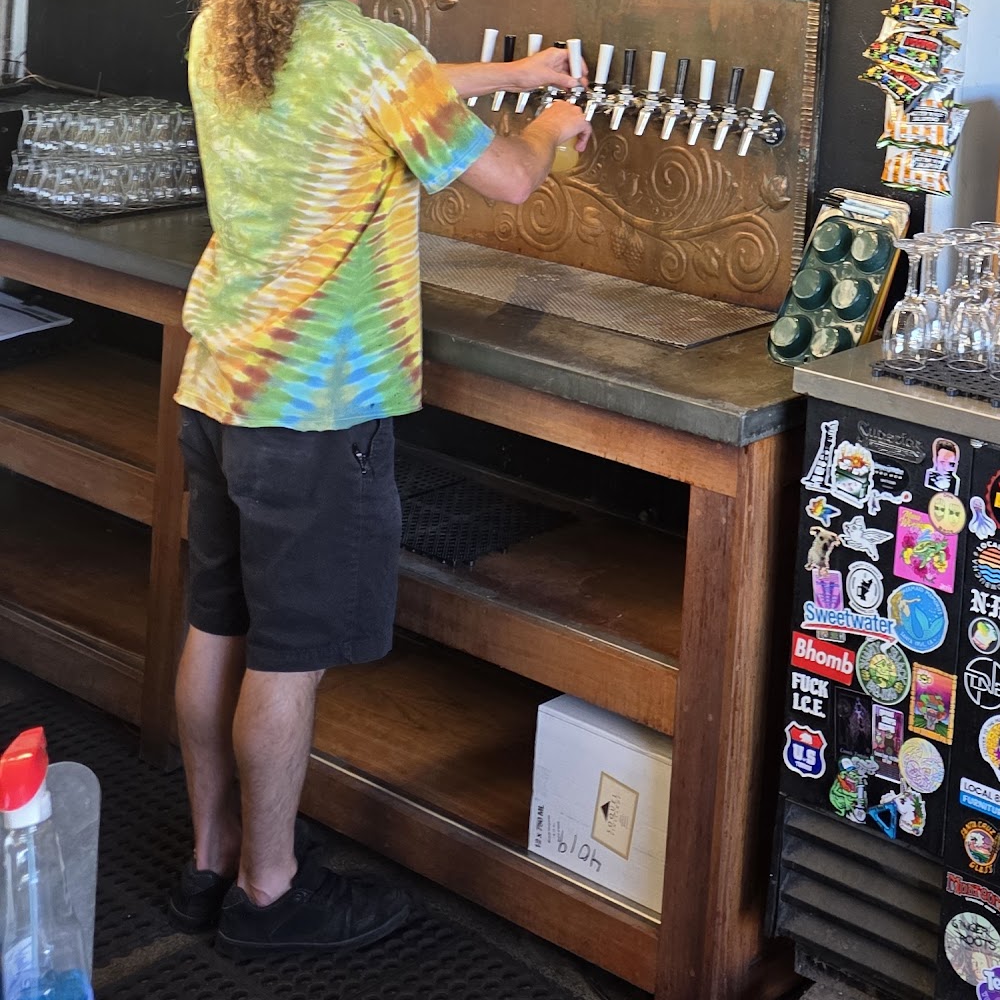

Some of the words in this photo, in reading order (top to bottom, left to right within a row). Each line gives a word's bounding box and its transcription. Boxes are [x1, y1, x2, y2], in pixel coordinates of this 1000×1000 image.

[805, 603, 894, 633] Sweetwater
[794, 637, 854, 675] Bhomb
[791, 672, 829, 698] FUCK
[964, 782, 993, 798] LOCAL
[959, 930, 996, 951] ROOTS
